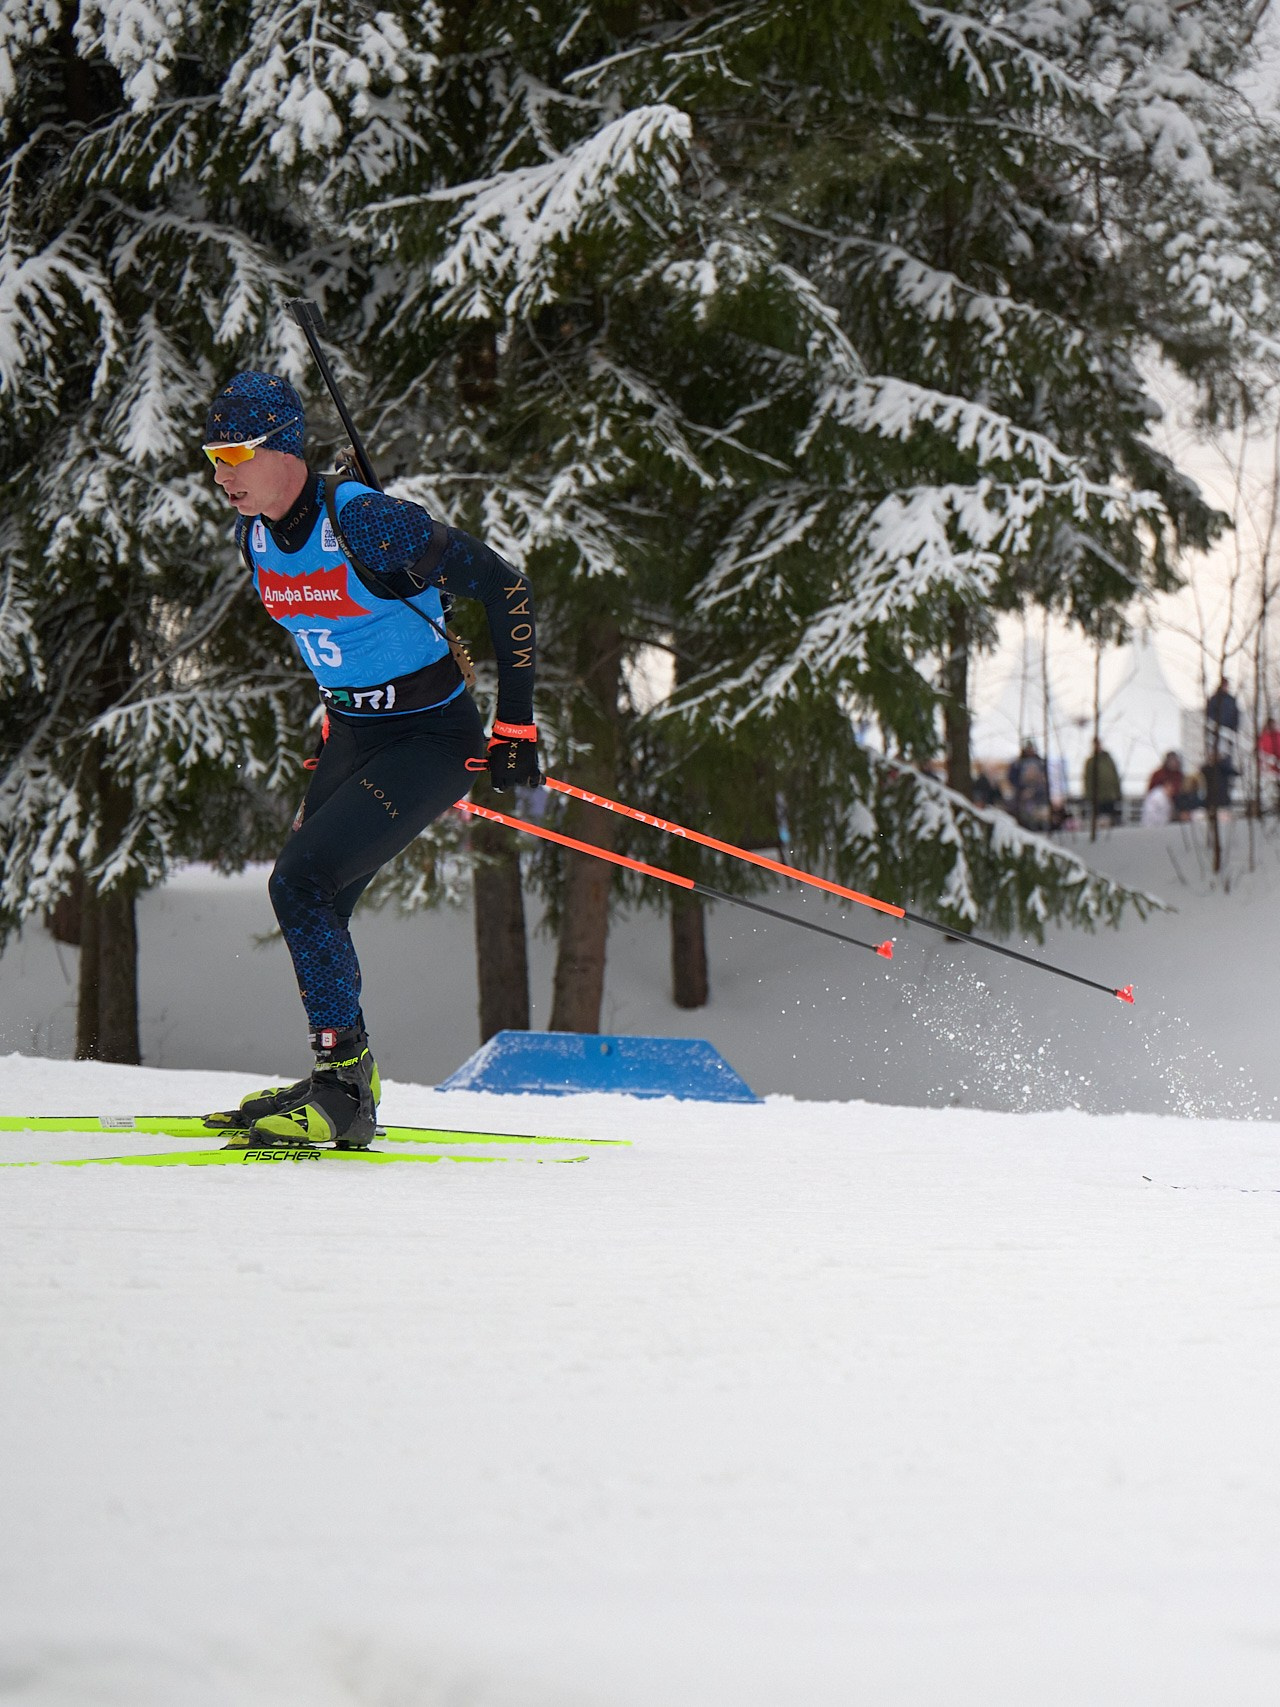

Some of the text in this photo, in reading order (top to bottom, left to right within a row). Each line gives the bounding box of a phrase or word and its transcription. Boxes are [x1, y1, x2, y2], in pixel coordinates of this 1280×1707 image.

[220, 430, 254, 442] MOA
[264, 585, 343, 606] Альфа Банк
[503, 578, 533, 669] MOAX
[297, 628, 342, 668] 13
[359, 778, 400, 819] MOAX
[243, 1151, 321, 1161] FISCHER
